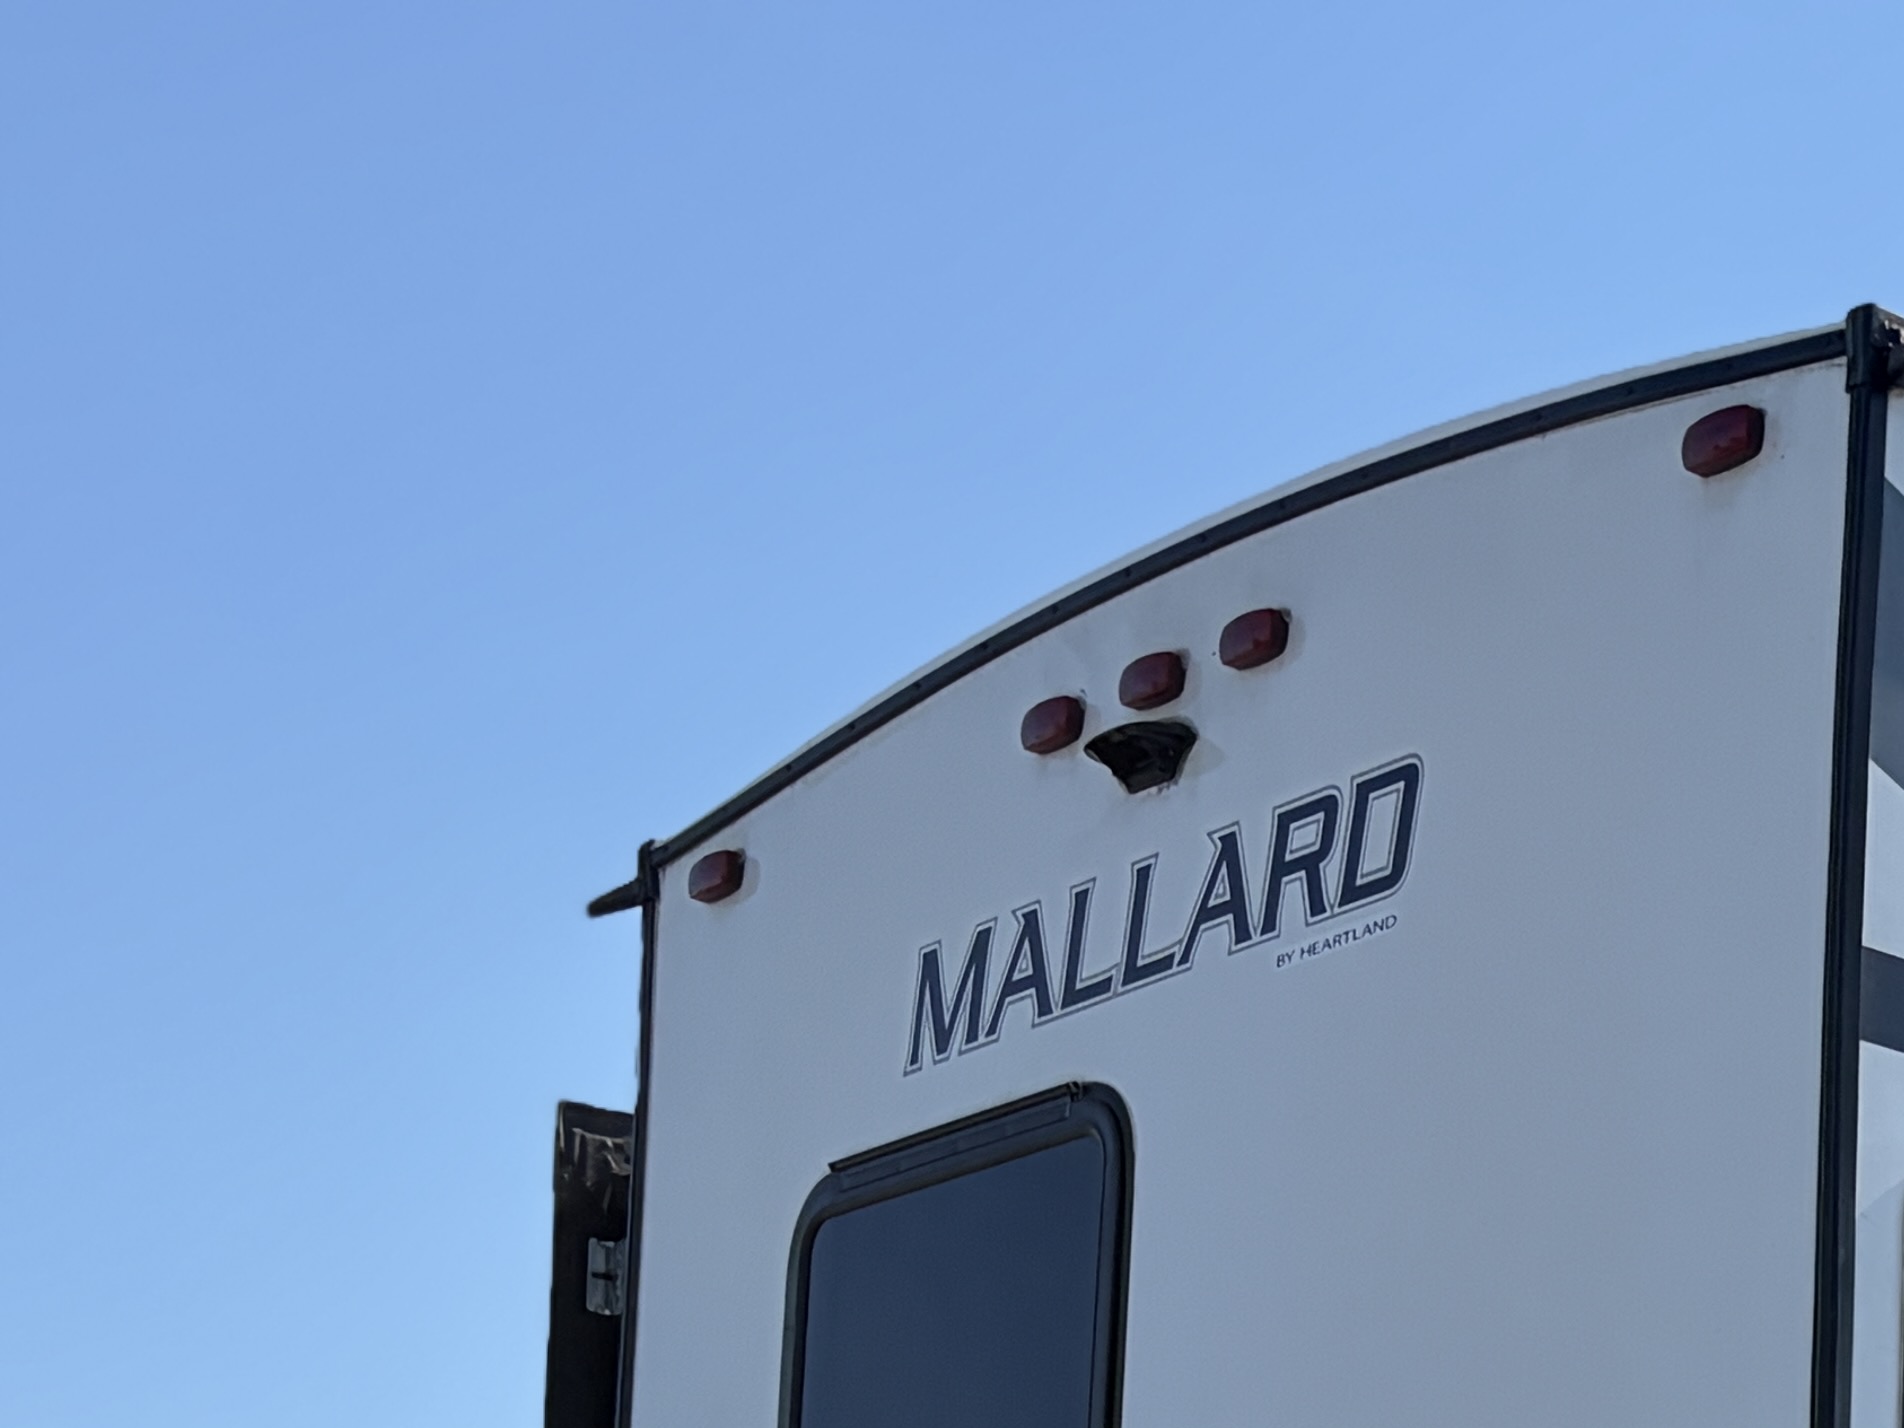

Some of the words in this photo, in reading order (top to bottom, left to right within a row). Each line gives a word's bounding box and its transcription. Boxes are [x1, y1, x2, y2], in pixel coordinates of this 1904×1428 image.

[903, 753, 1424, 1076] MALLARD
[1276, 950, 1295, 968] BY
[1300, 914, 1397, 959] HEARTLAND
